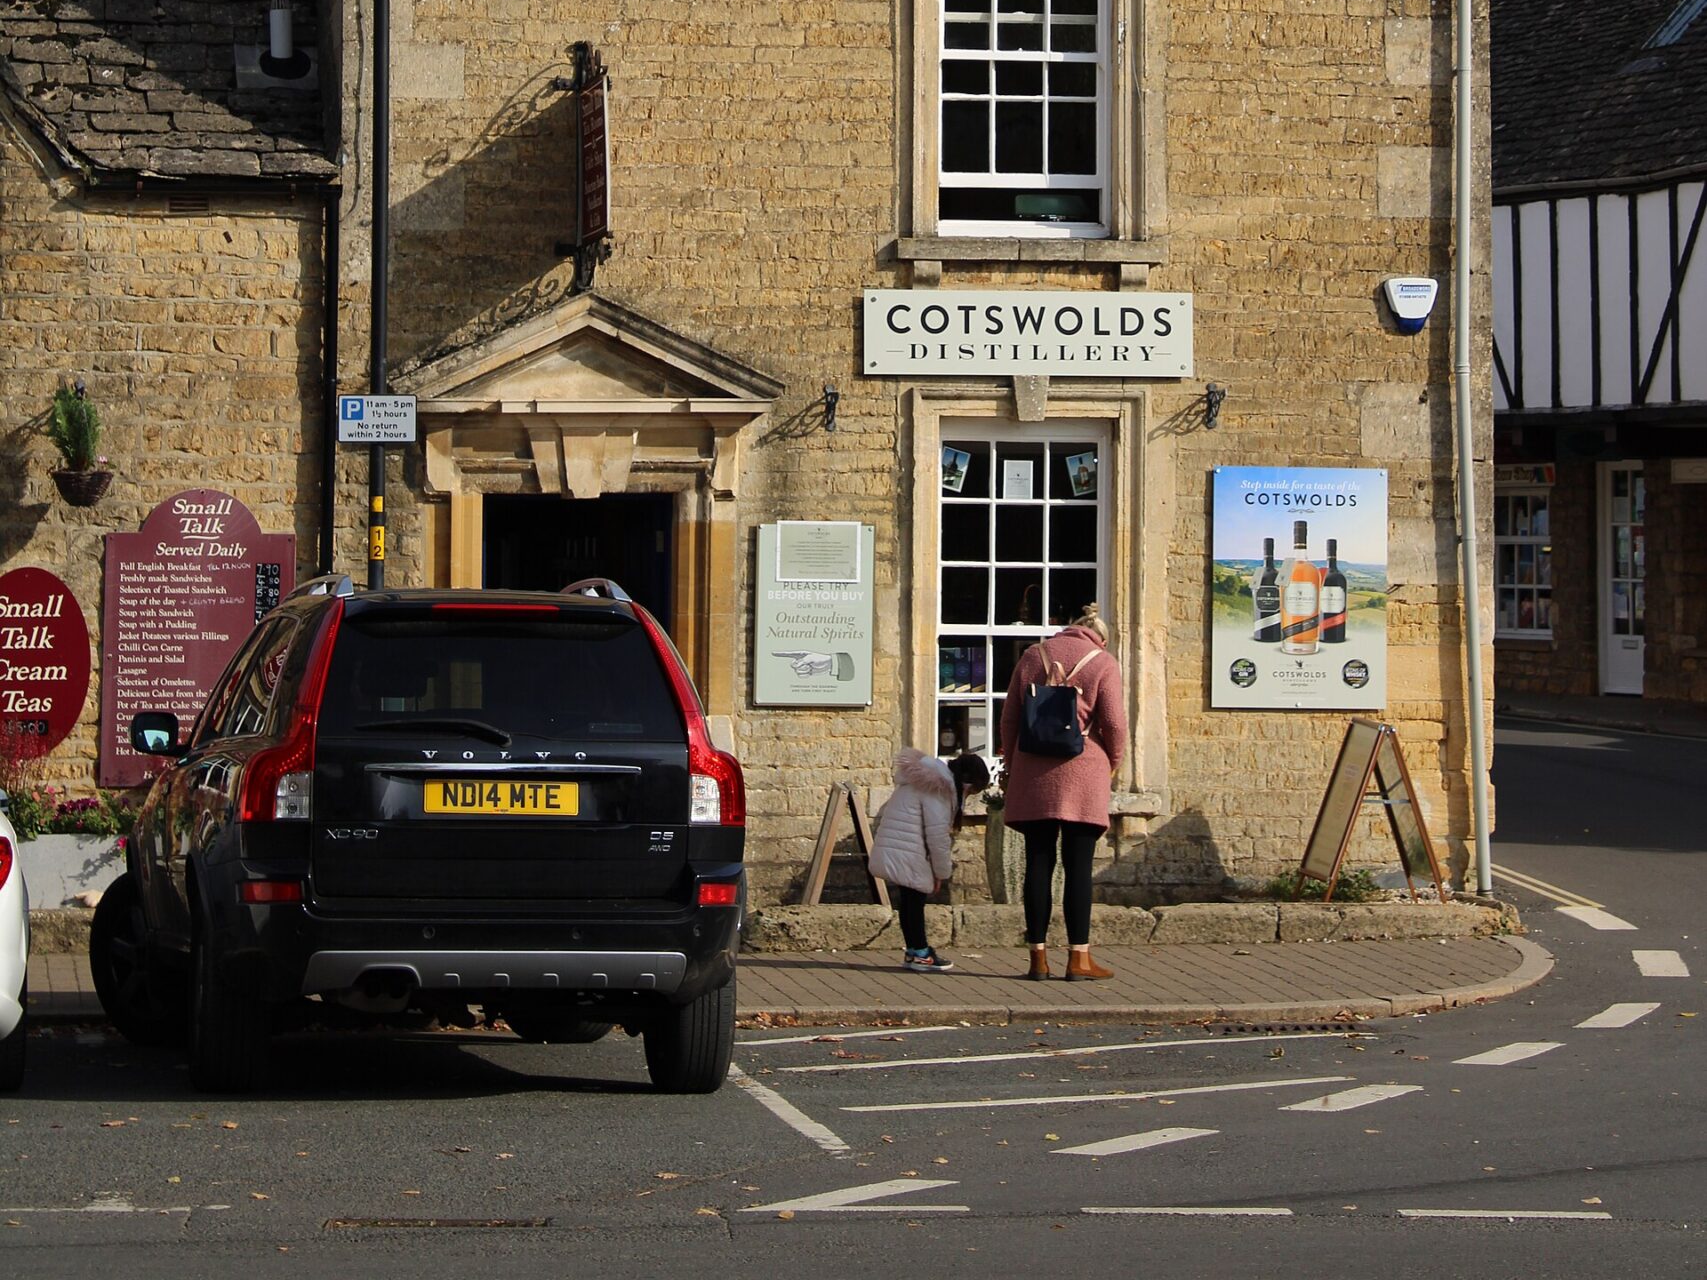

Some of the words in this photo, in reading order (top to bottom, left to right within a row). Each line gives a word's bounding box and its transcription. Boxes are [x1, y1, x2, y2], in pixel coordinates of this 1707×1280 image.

[887, 304, 1172, 337] COTSWOLDS
[909, 343, 1156, 361] DISTILLERY
[347, 401, 360, 418] P
[1240, 480, 1262, 492] Step
[1264, 480, 1289, 489] inside
[1290, 480, 1305, 492] for
[1313, 481, 1335, 490] taste
[1336, 481, 1347, 491] of
[1348, 481, 1360, 491] the
[1244, 492, 1357, 507] COTSWOLDS
[172, 499, 233, 515] Small
[179, 518, 226, 534] Talk
[156, 542, 204, 556] Served
[208, 543, 247, 559] Daily
[137, 563, 165, 573] English
[167, 563, 201, 571] Breakfast
[120, 574, 145, 583] Freshly
[148, 574, 168, 582] made
[120, 586, 151, 594] Selection
[153, 585, 161, 594] of
[163, 586, 189, 594] Toasted
[191, 586, 227, 594] Sandwich
[784, 581, 824, 590] PLEASE
[829, 582, 848, 590] TRY
[768, 590, 812, 600] BEFORE
[814, 591, 839, 601] YOU
[842, 592, 864, 601] BUY
[0, 594, 64, 618] Small
[119, 597, 137, 607] Soup
[139, 597, 147, 605] of
[149, 597, 162, 605] the
[163, 597, 176, 607] day
[119, 609, 137, 618] Soup
[139, 608, 156, 617] with
[158, 609, 194, 617] Sandwich
[775, 611, 855, 626] Outstanding
[119, 620, 137, 630] Soup
[139, 620, 156, 629] with
[165, 620, 196, 630] Pudding
[1, 626, 55, 649] Talk
[118, 632, 140, 641] Jacket
[142, 632, 171, 641] Potatoes
[173, 633, 199, 641] various
[201, 632, 229, 642] Fillings
[766, 626, 817, 639] Natural
[821, 628, 864, 643] Spirits
[118, 643, 141, 652] Chilli
[142, 644, 159, 652] Con
[160, 644, 183, 652] Carne
[118, 655, 147, 663] Paninis
[149, 655, 163, 663] and
[164, 655, 185, 663] Salad
[0, 659, 67, 681] Cream
[118, 667, 147, 675] Lasagne
[117, 678, 149, 686] Selection
[151, 678, 159, 686] of
[160, 678, 195, 686] Omelettes
[117, 689, 150, 698] Delicious
[152, 689, 174, 698] Cakes
[176, 689, 194, 698] from
[195, 689, 208, 698] the
[1, 691, 52, 713] Teas
[117, 701, 128, 710] Pot
[130, 701, 138, 709] of
[140, 701, 153, 709] Tea
[154, 701, 168, 709] and
[170, 701, 190, 710] Cake
[116, 747, 131, 756] Hot
[422, 750, 587, 761] VOLVO
[443, 782, 501, 808] ND14
[509, 783, 561, 809] MTE
[649, 831, 674, 840] D5
[648, 844, 671, 852] AWD
